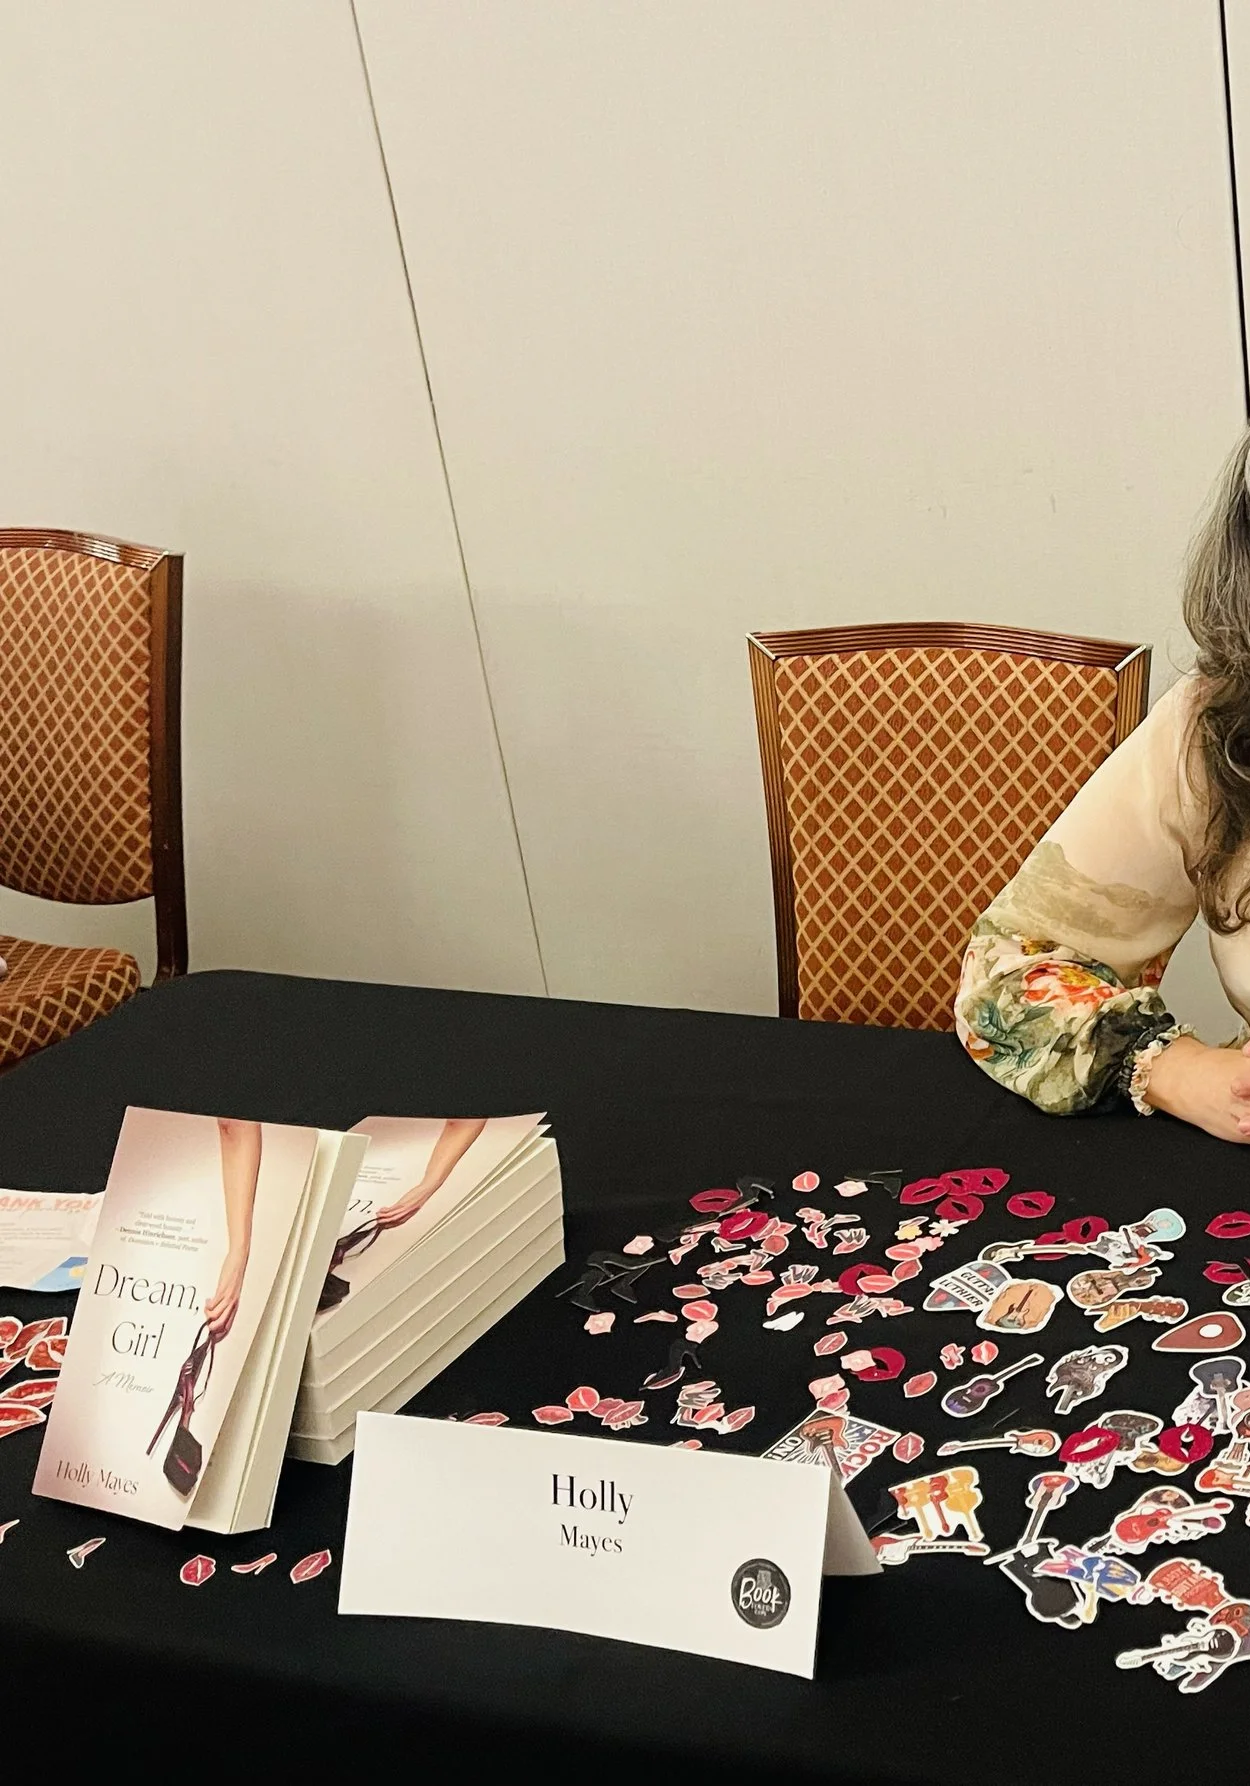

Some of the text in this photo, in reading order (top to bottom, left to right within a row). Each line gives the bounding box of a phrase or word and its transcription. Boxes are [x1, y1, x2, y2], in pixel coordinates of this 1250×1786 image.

[94, 1264, 199, 1314] Dream,
[939, 1279, 984, 1307] LUTHIER
[112, 1321, 165, 1359] Girl
[115, 1372, 155, 1395] Memoir
[56, 1460, 140, 1495] Holly Mayes
[551, 1473, 634, 1524] Holly
[559, 1523, 623, 1557] Mayes
